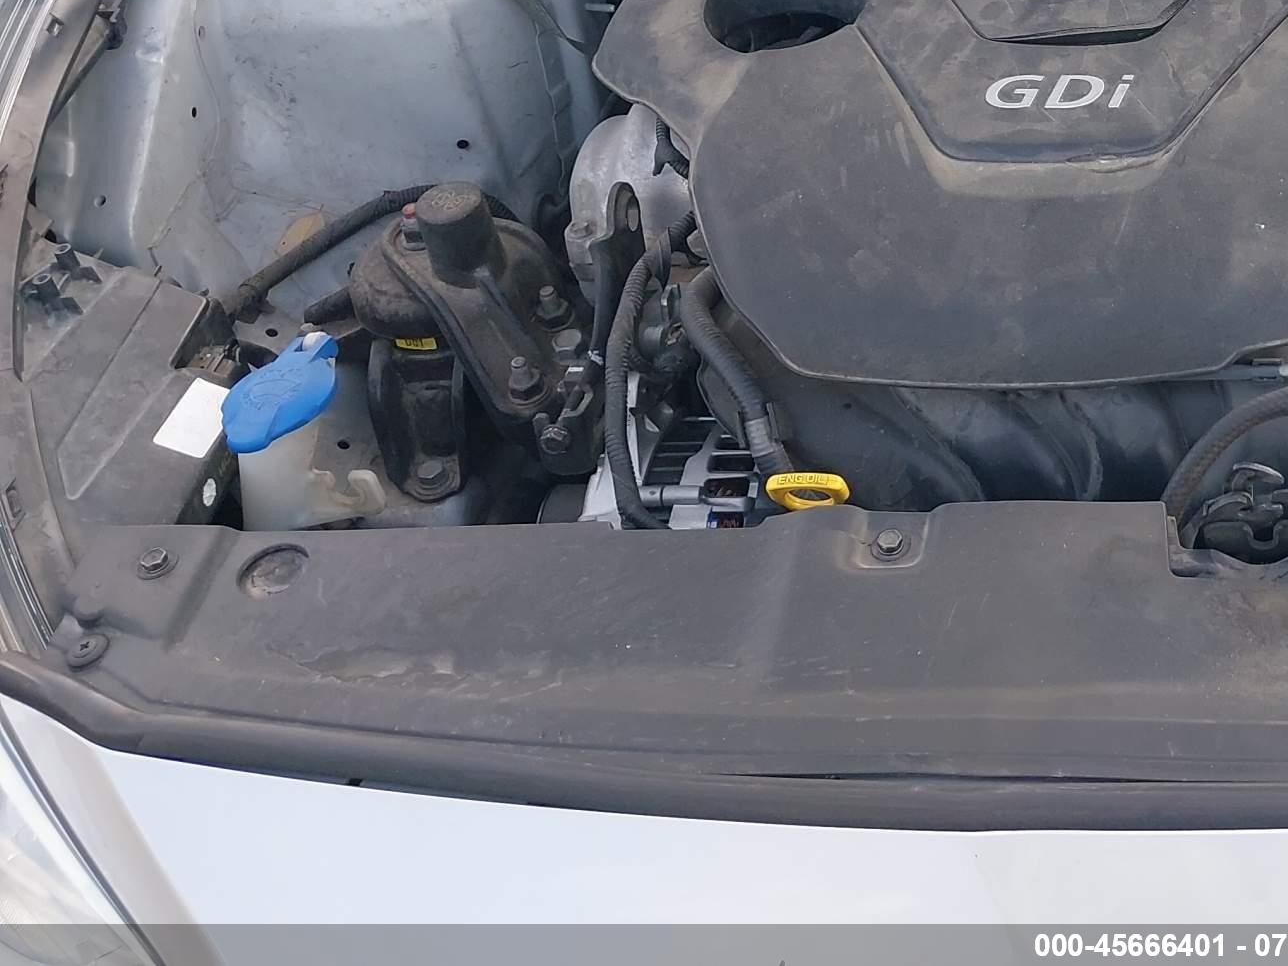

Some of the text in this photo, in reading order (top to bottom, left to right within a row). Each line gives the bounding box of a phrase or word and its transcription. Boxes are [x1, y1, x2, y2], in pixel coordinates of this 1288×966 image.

[985, 74, 1135, 109] GDi
[778, 474, 826, 485] ENG OIL
